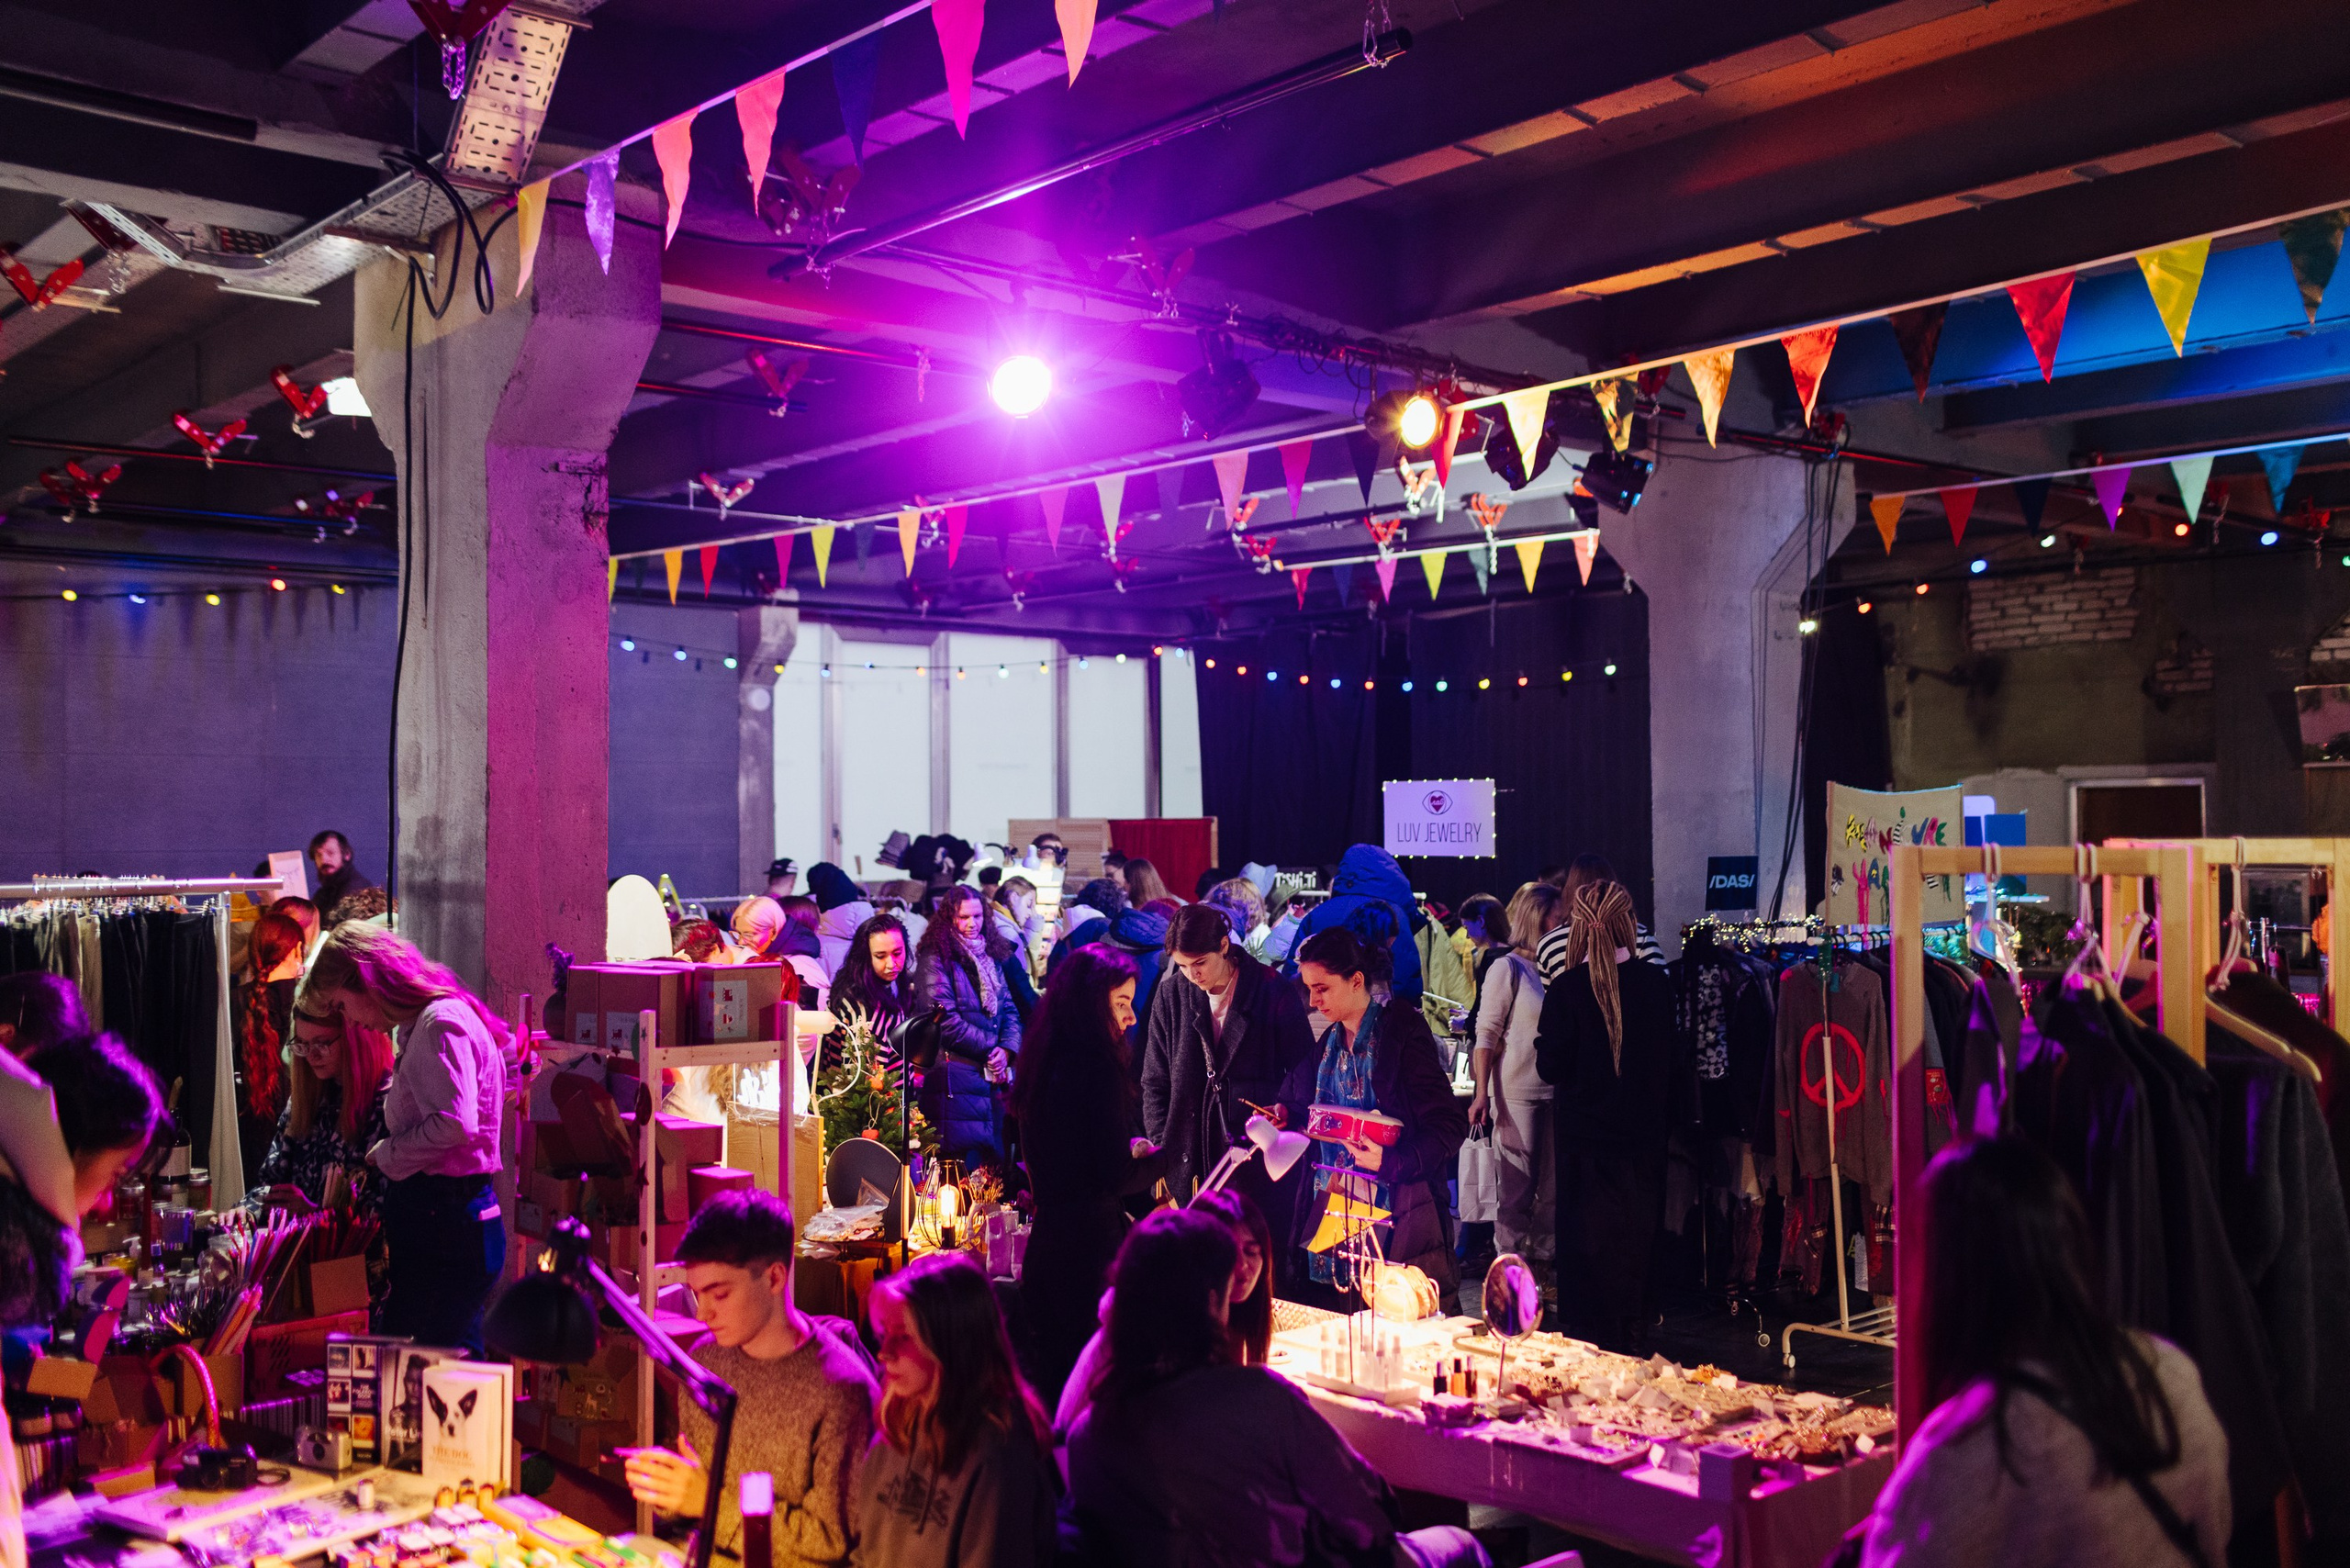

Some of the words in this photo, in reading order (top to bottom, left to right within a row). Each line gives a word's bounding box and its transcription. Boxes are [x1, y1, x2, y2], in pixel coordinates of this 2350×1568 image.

[1397, 823, 1421, 843] LUV
[1425, 823, 1483, 843] JEWELRY
[1708, 874, 1756, 889] /DAS/
